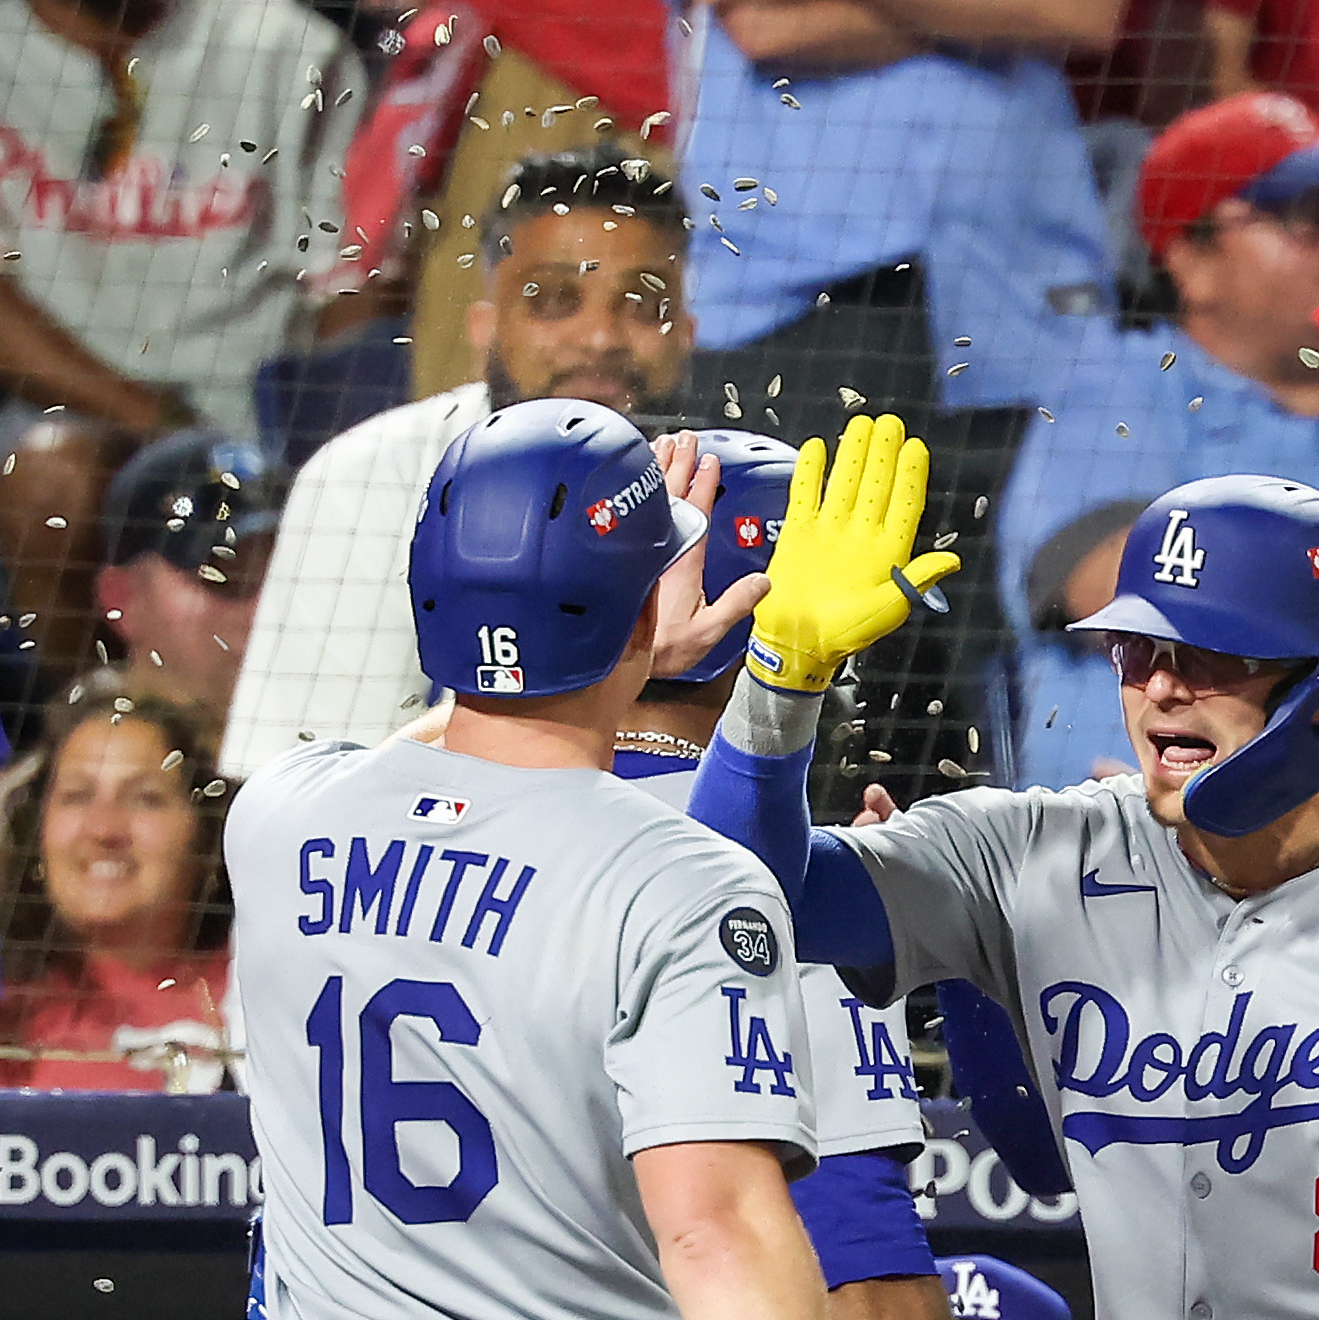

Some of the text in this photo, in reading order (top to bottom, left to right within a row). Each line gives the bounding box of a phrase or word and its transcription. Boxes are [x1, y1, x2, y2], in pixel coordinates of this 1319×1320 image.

[1154, 509, 1205, 587] LA
[478, 626, 518, 667] 16
[297, 836, 537, 958] SMITH
[733, 930, 770, 965] 34
[721, 987, 796, 1097] LA
[840, 998, 914, 1101] LA
[306, 976, 500, 1226] 16
[949, 1261, 1002, 1320] LA
